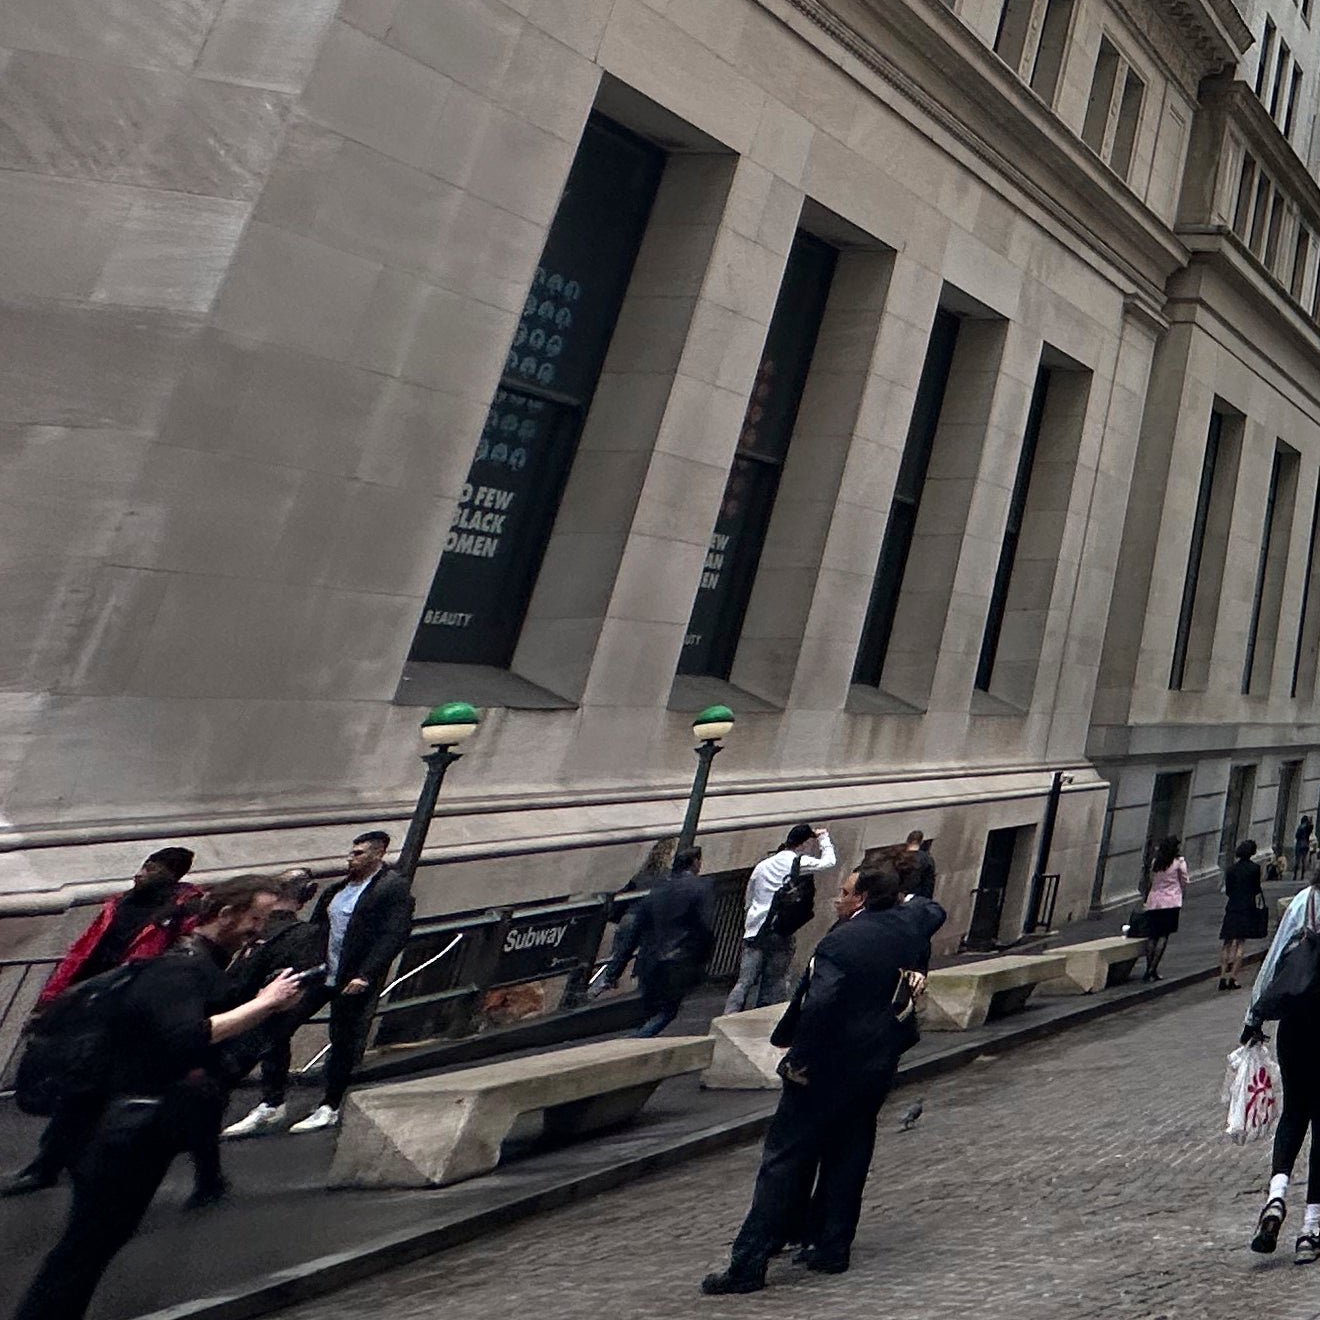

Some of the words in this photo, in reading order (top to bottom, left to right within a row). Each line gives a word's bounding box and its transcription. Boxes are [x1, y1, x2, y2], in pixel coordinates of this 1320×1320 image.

[474, 486, 516, 511] FEW
[443, 532, 499, 558] OMEN
[423, 610, 473, 626] BEAUTY
[504, 924, 567, 952] Subway
